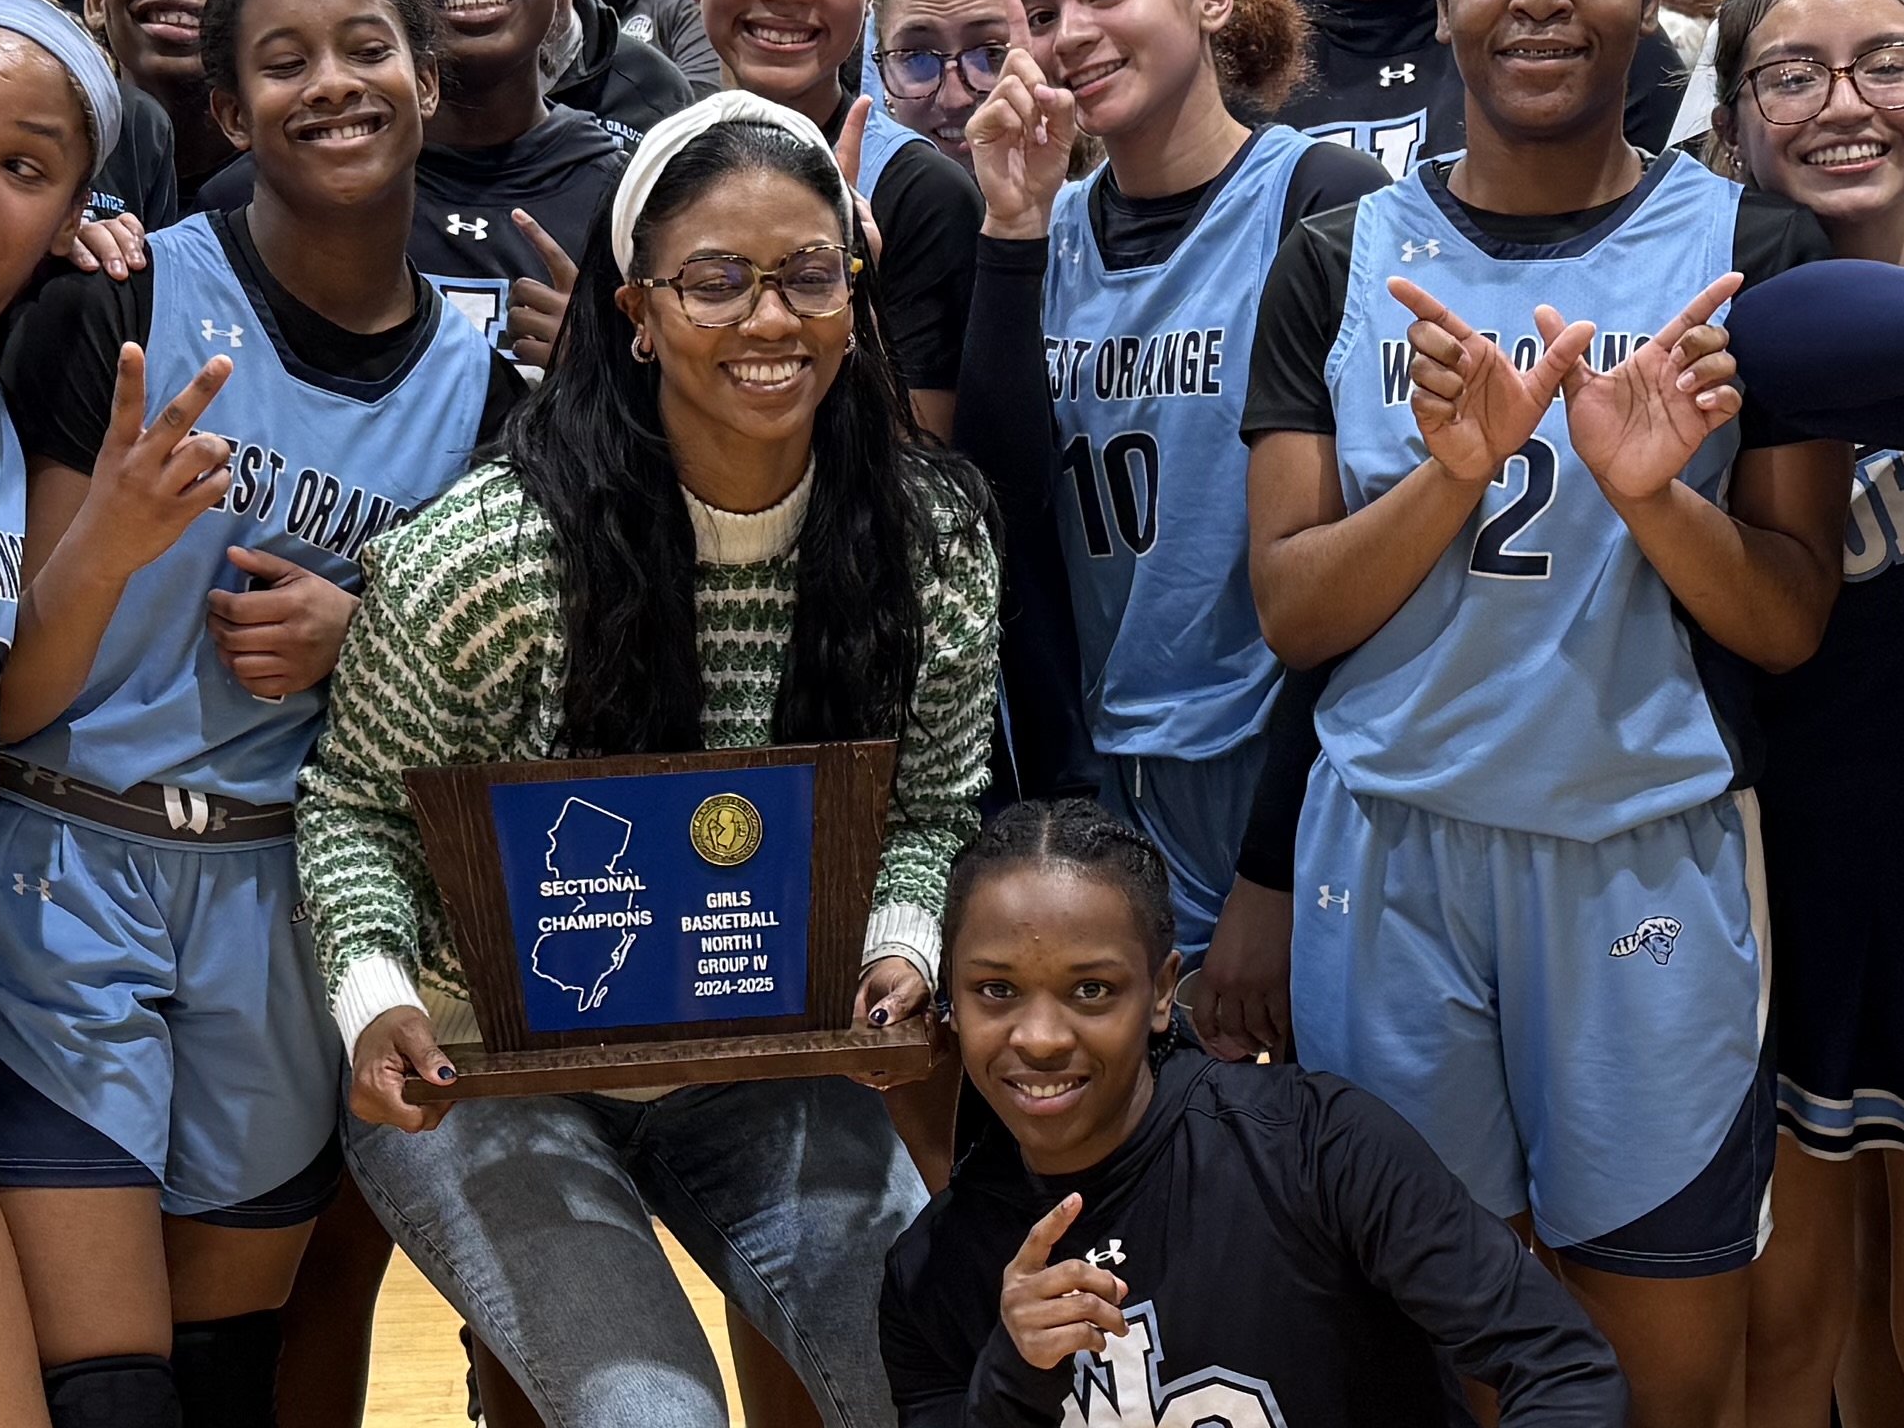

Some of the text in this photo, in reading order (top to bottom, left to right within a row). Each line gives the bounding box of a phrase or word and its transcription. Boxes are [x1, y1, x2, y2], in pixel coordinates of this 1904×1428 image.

[1094, 327, 1226, 402] ORANGE
[1062, 430, 1160, 558] 10
[1467, 434, 1560, 580] 2
[540, 875, 647, 897] SECTIONAL
[706, 890, 752, 909] GIRLS
[538, 910, 653, 933] CHAMPIONS
[681, 911, 780, 933] BASKETBALL
[701, 933, 762, 953] NORTH I
[697, 954, 768, 975] GROUP IV
[694, 977, 775, 997] 2024-2025
